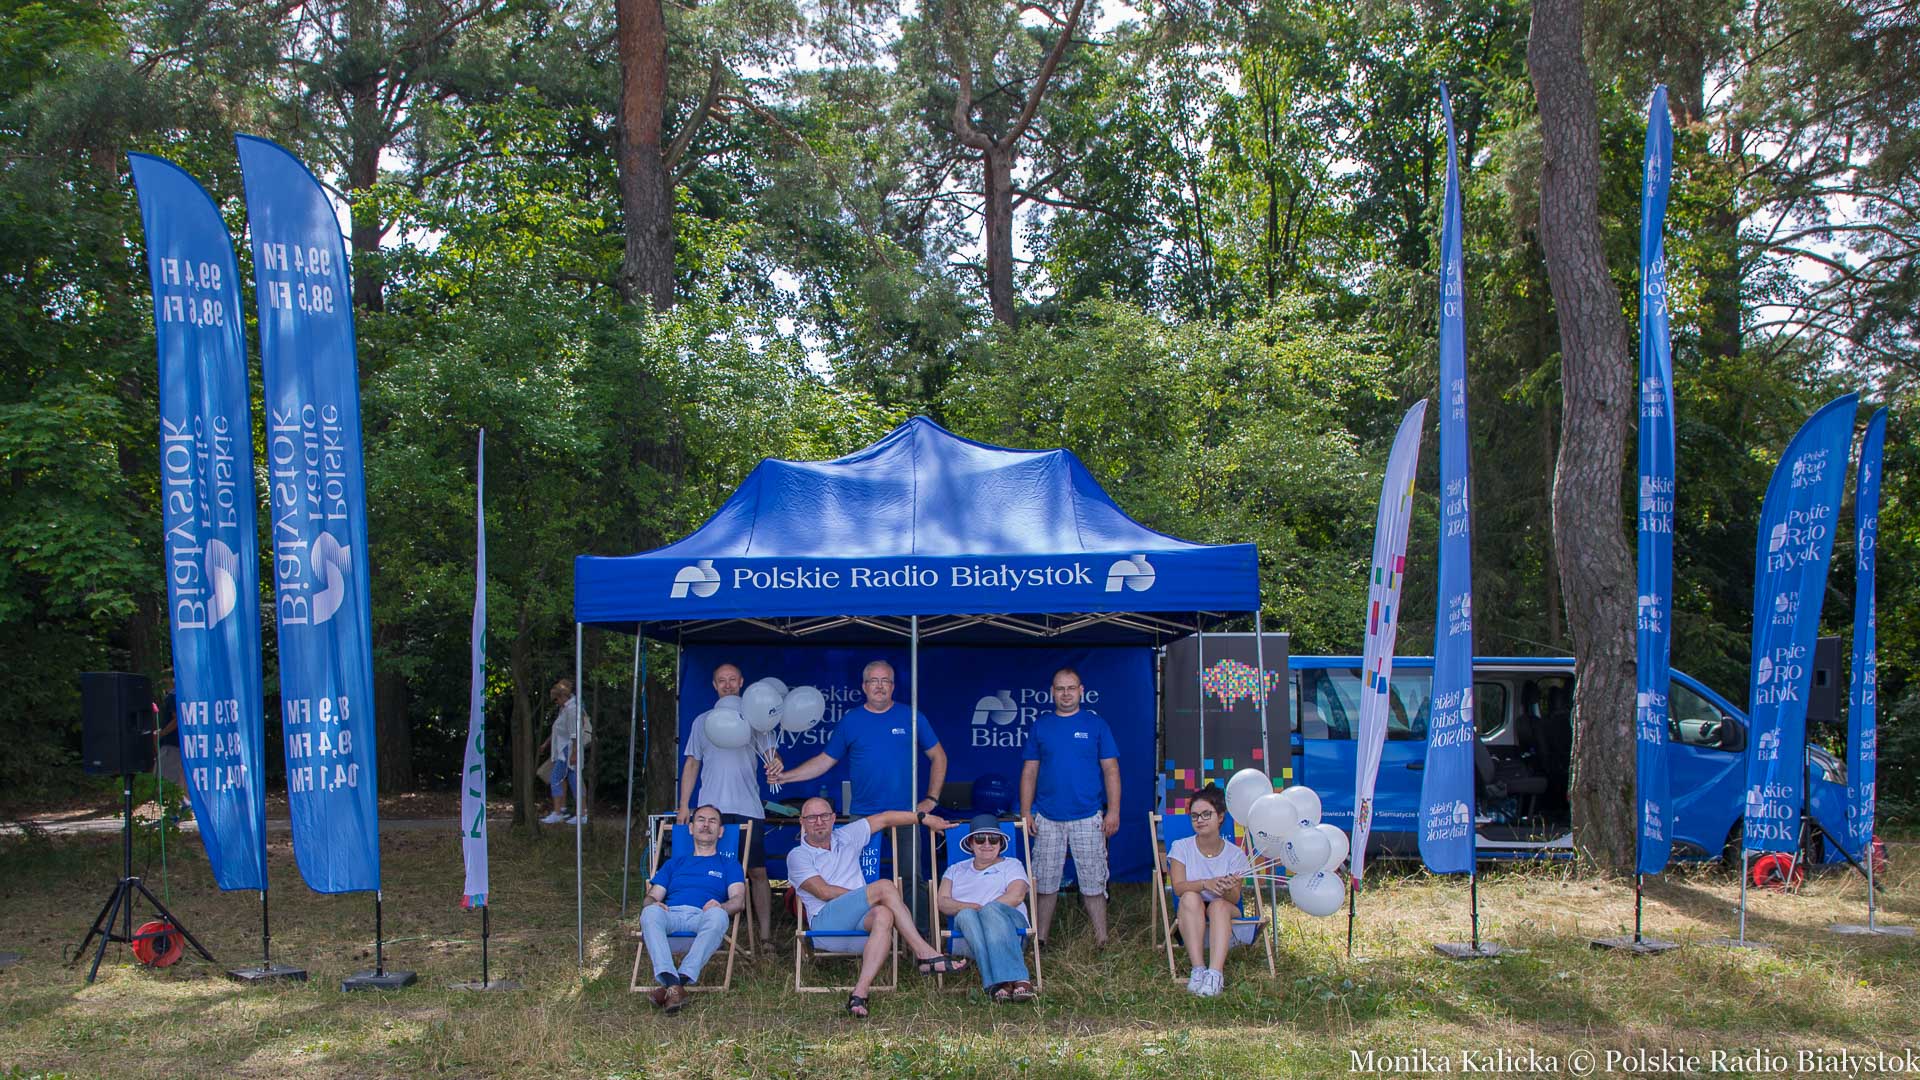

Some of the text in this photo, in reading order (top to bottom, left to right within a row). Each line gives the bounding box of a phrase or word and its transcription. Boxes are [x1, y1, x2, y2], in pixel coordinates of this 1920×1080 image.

[732, 561, 1093, 592] Polskie Radio Białystok
